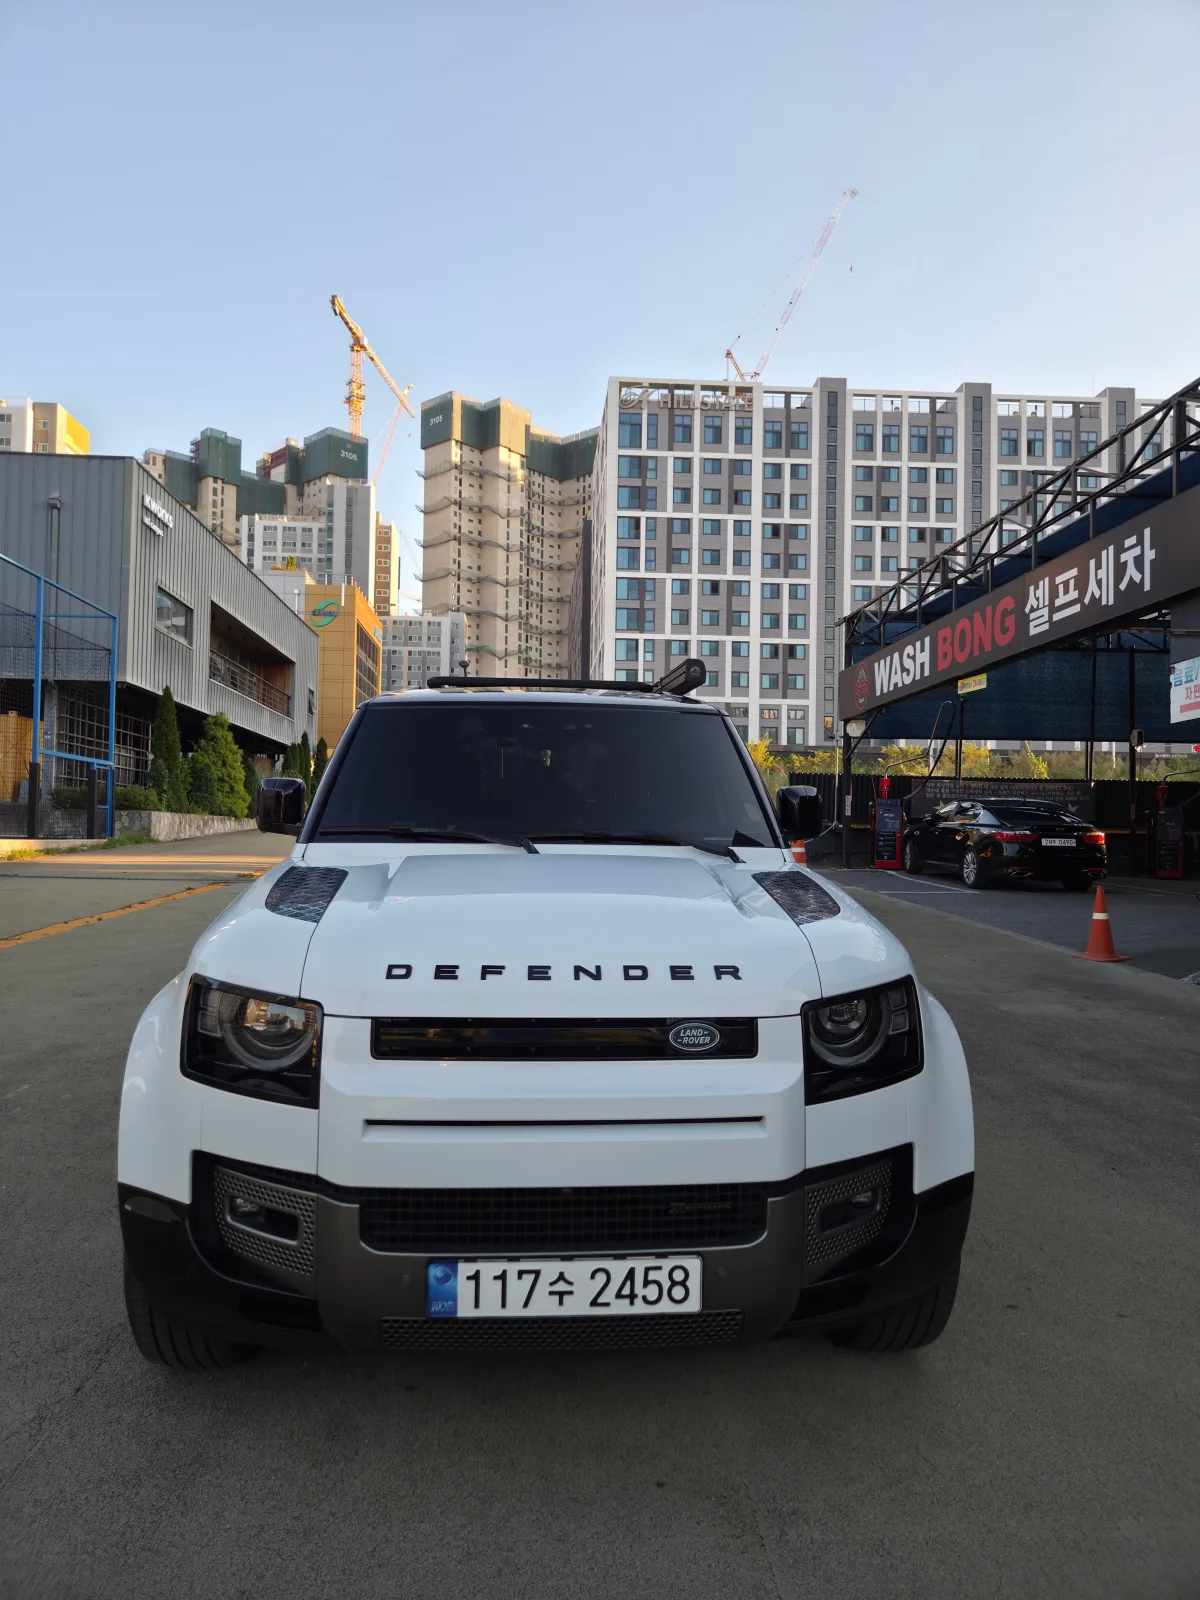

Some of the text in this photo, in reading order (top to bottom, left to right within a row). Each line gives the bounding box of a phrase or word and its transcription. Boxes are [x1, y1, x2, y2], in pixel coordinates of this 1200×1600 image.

[874, 526, 1156, 697] WASH BONG 셀프세차
[385, 964, 743, 981] DEFENDER
[466, 1265, 690, 1309] 117수 2458
